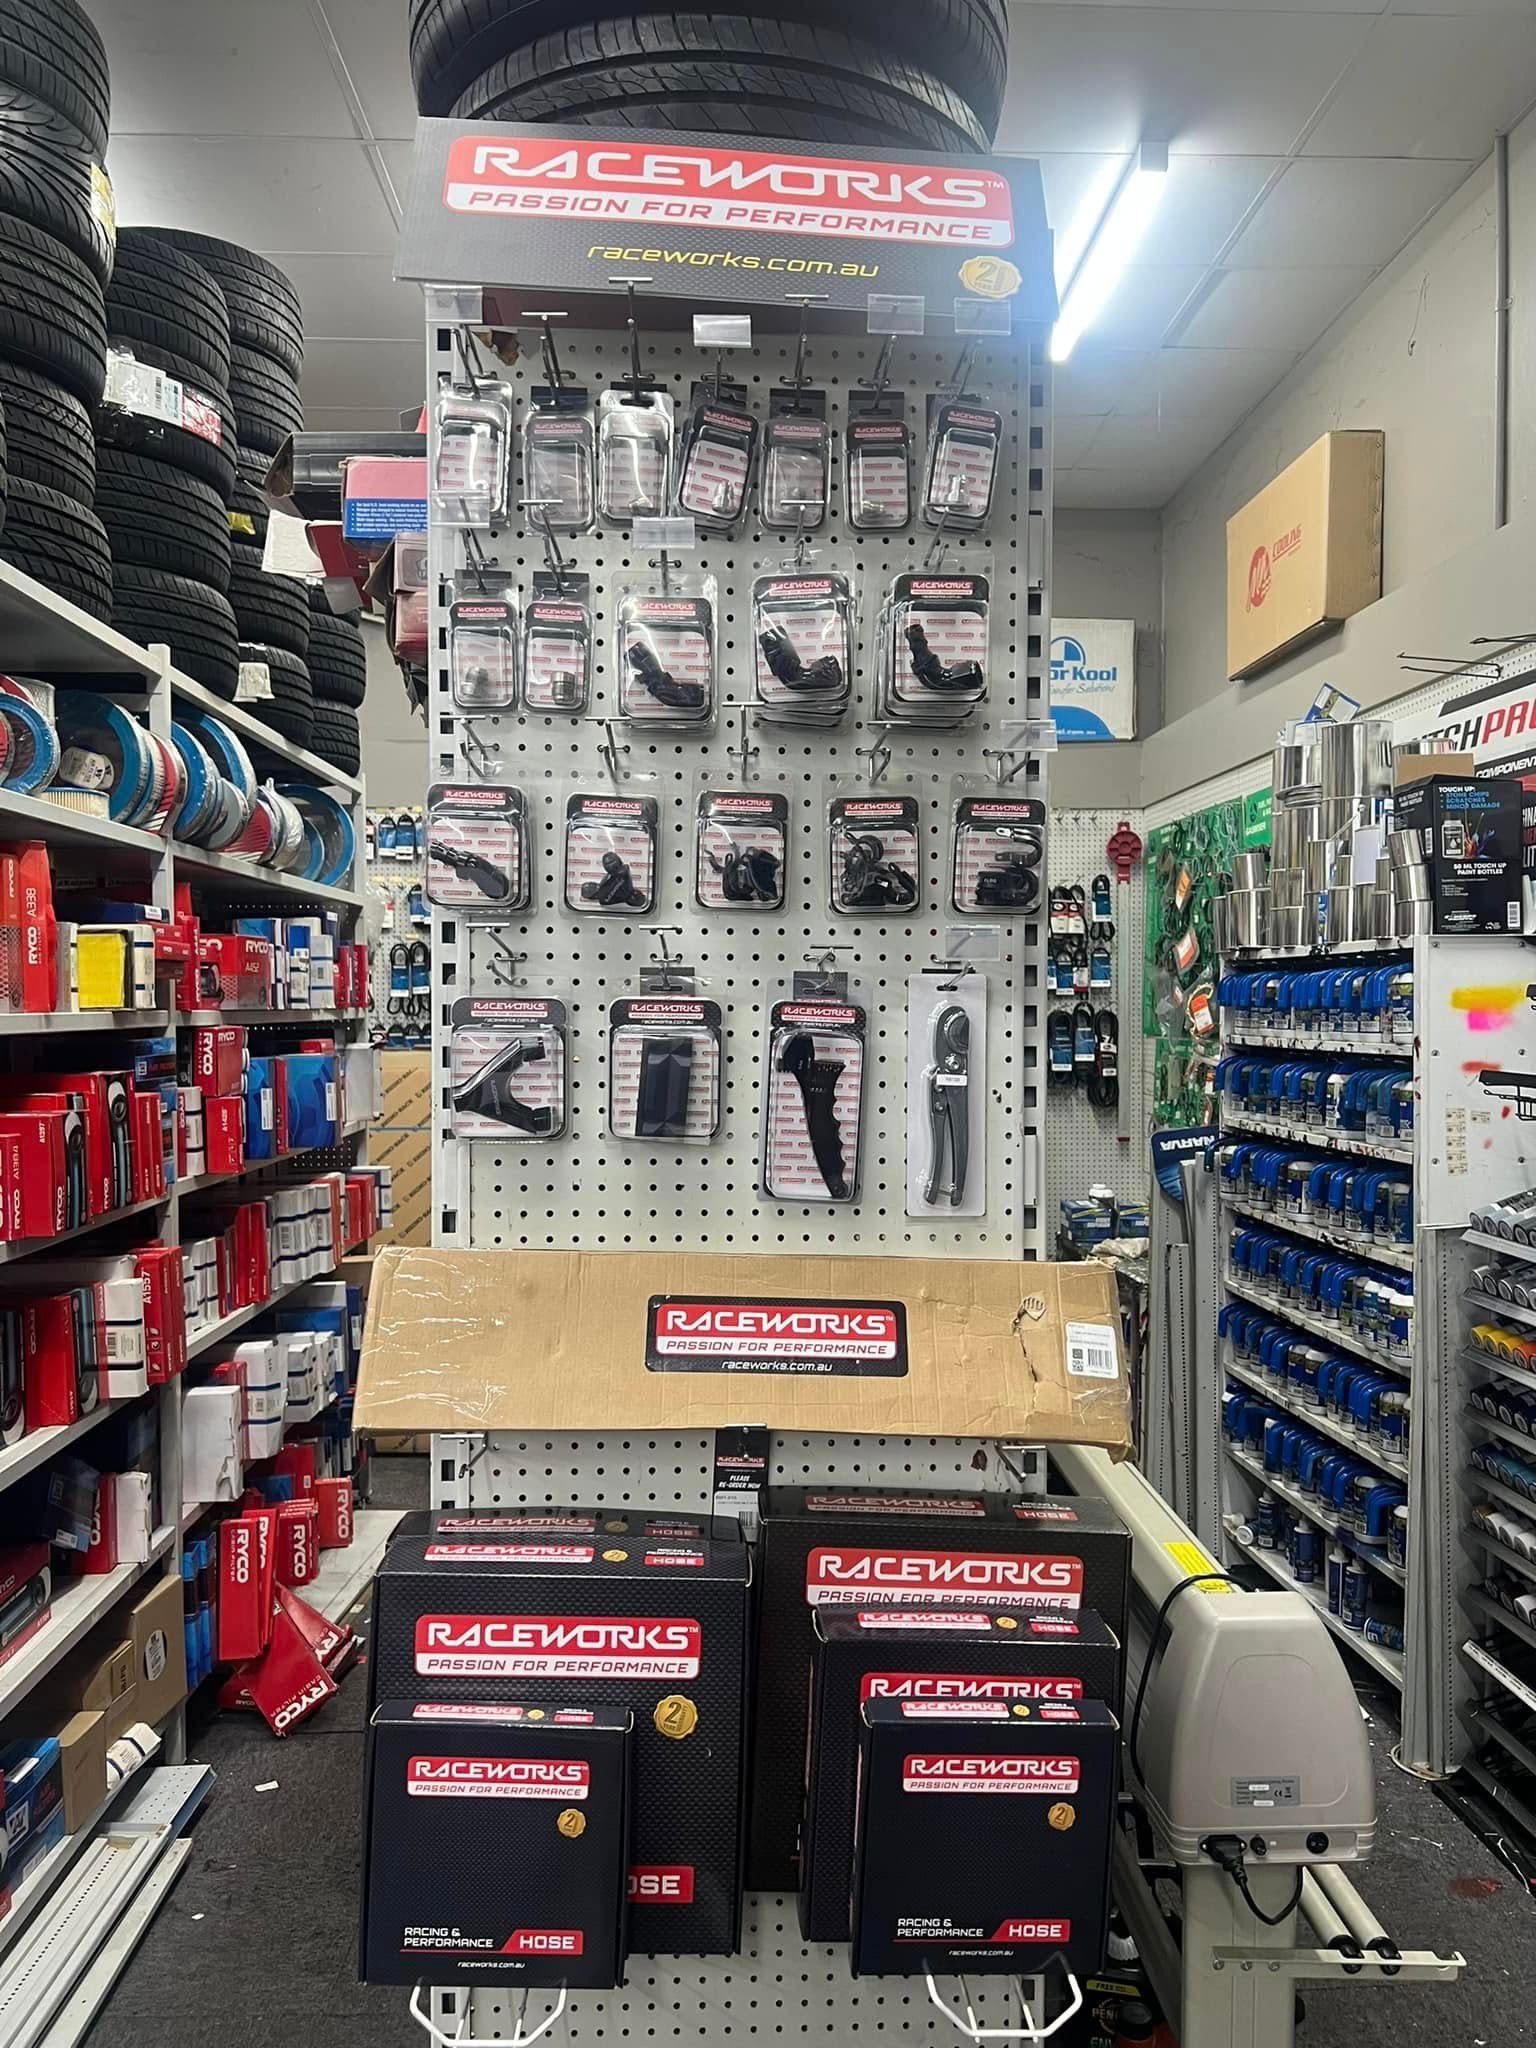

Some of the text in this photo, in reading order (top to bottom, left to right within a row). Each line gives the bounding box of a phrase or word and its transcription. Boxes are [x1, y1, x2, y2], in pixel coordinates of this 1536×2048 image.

[469, 191, 992, 240] PASSION FOR PERFORMANCE
[587, 246, 880, 278] raceworks.com.au
[1072, 667, 1117, 681] Kool
[26, 887, 37, 918] A338
[28, 926, 38, 964] RYCO
[245, 940, 269, 954] RYCO
[473, 1002, 547, 1011] RACEWORKS
[631, 1003, 703, 1012] RACEWORKS
[784, 1006, 854, 1018] RACEWORKS
[203, 1032, 213, 1076] RYCO
[1160, 1135, 1215, 1151] NARVA
[666, 1340, 888, 1355] PASSION FOR PERFORMANCE
[721, 1360, 833, 1372] raceworks.com.au
[812, 1496, 975, 1509] RACEWORKS
[338, 1489, 349, 1539] RYCO
[1024, 1511, 1070, 1520] HOSE
[446, 1517, 591, 1527] RACEWORKS
[236, 1528, 249, 1584] RYCO
[293, 1524, 307, 1578] RYCO
[435, 1546, 587, 1556] RACEWORKS
[653, 1556, 696, 1565] HOSE
[818, 1590, 1071, 1609] PASSION FOR PERFORMANCE
[863, 1613, 986, 1623] RACEWORKS
[427, 1658, 688, 1675] PASSION FOR PERFORMANCE
[274, 1679, 329, 1729] RYCO
[664, 1701, 682, 1724] 2
[415, 1784, 582, 1797] PASSION FOR PERFORMANCE
[910, 1780, 1073, 1791] PASSION FOR PERFORMANCE
[565, 1813, 575, 1828] 2
[1055, 1806, 1066, 1822] 2
[898, 1918, 952, 1928] RACING &
[404, 1927, 461, 1937] RACING &
[897, 1928, 984, 1938] PERFORMANCE
[1009, 1924, 1062, 1938] HOSE
[404, 1937, 493, 1948] PERFORMANCE
[519, 1935, 575, 1950] HOSE
[949, 1949, 1014, 1957] raceworks.com.au
[458, 1961, 525, 1969] raceworks.com.au
